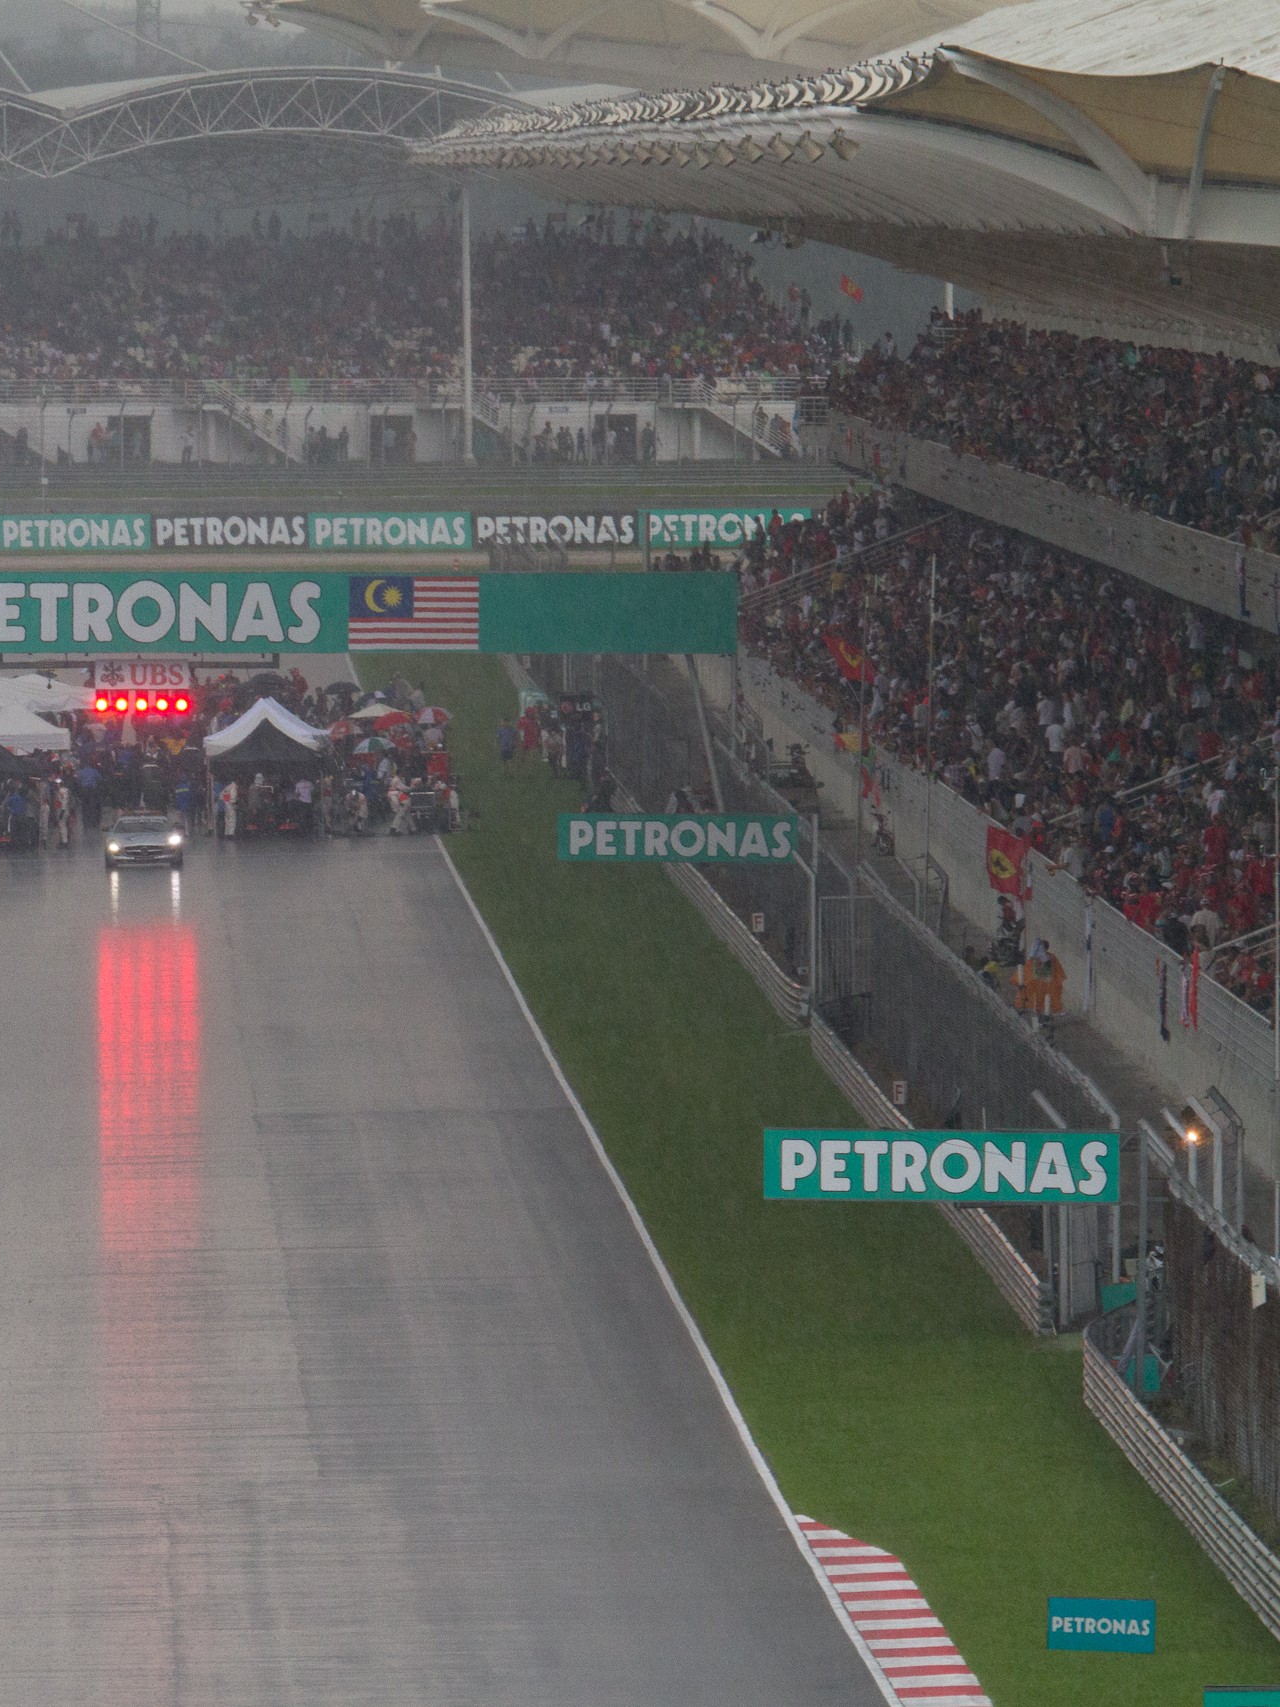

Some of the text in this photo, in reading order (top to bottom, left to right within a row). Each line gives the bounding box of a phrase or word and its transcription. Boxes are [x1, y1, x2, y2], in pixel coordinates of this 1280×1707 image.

[2, 518, 145, 548] PETRONAS
[156, 516, 305, 546] PETRONAS
[314, 516, 465, 546] PETRONAS
[477, 515, 634, 545] PETRONAS
[649, 513, 805, 542] PETRON
[128, 663, 184, 686] UBS
[576, 702, 591, 711] LG
[570, 820, 792, 859] PETRONAS
[780, 1138, 1108, 1196] PETRONAS
[1051, 1616, 1151, 1636] PETRONAS
